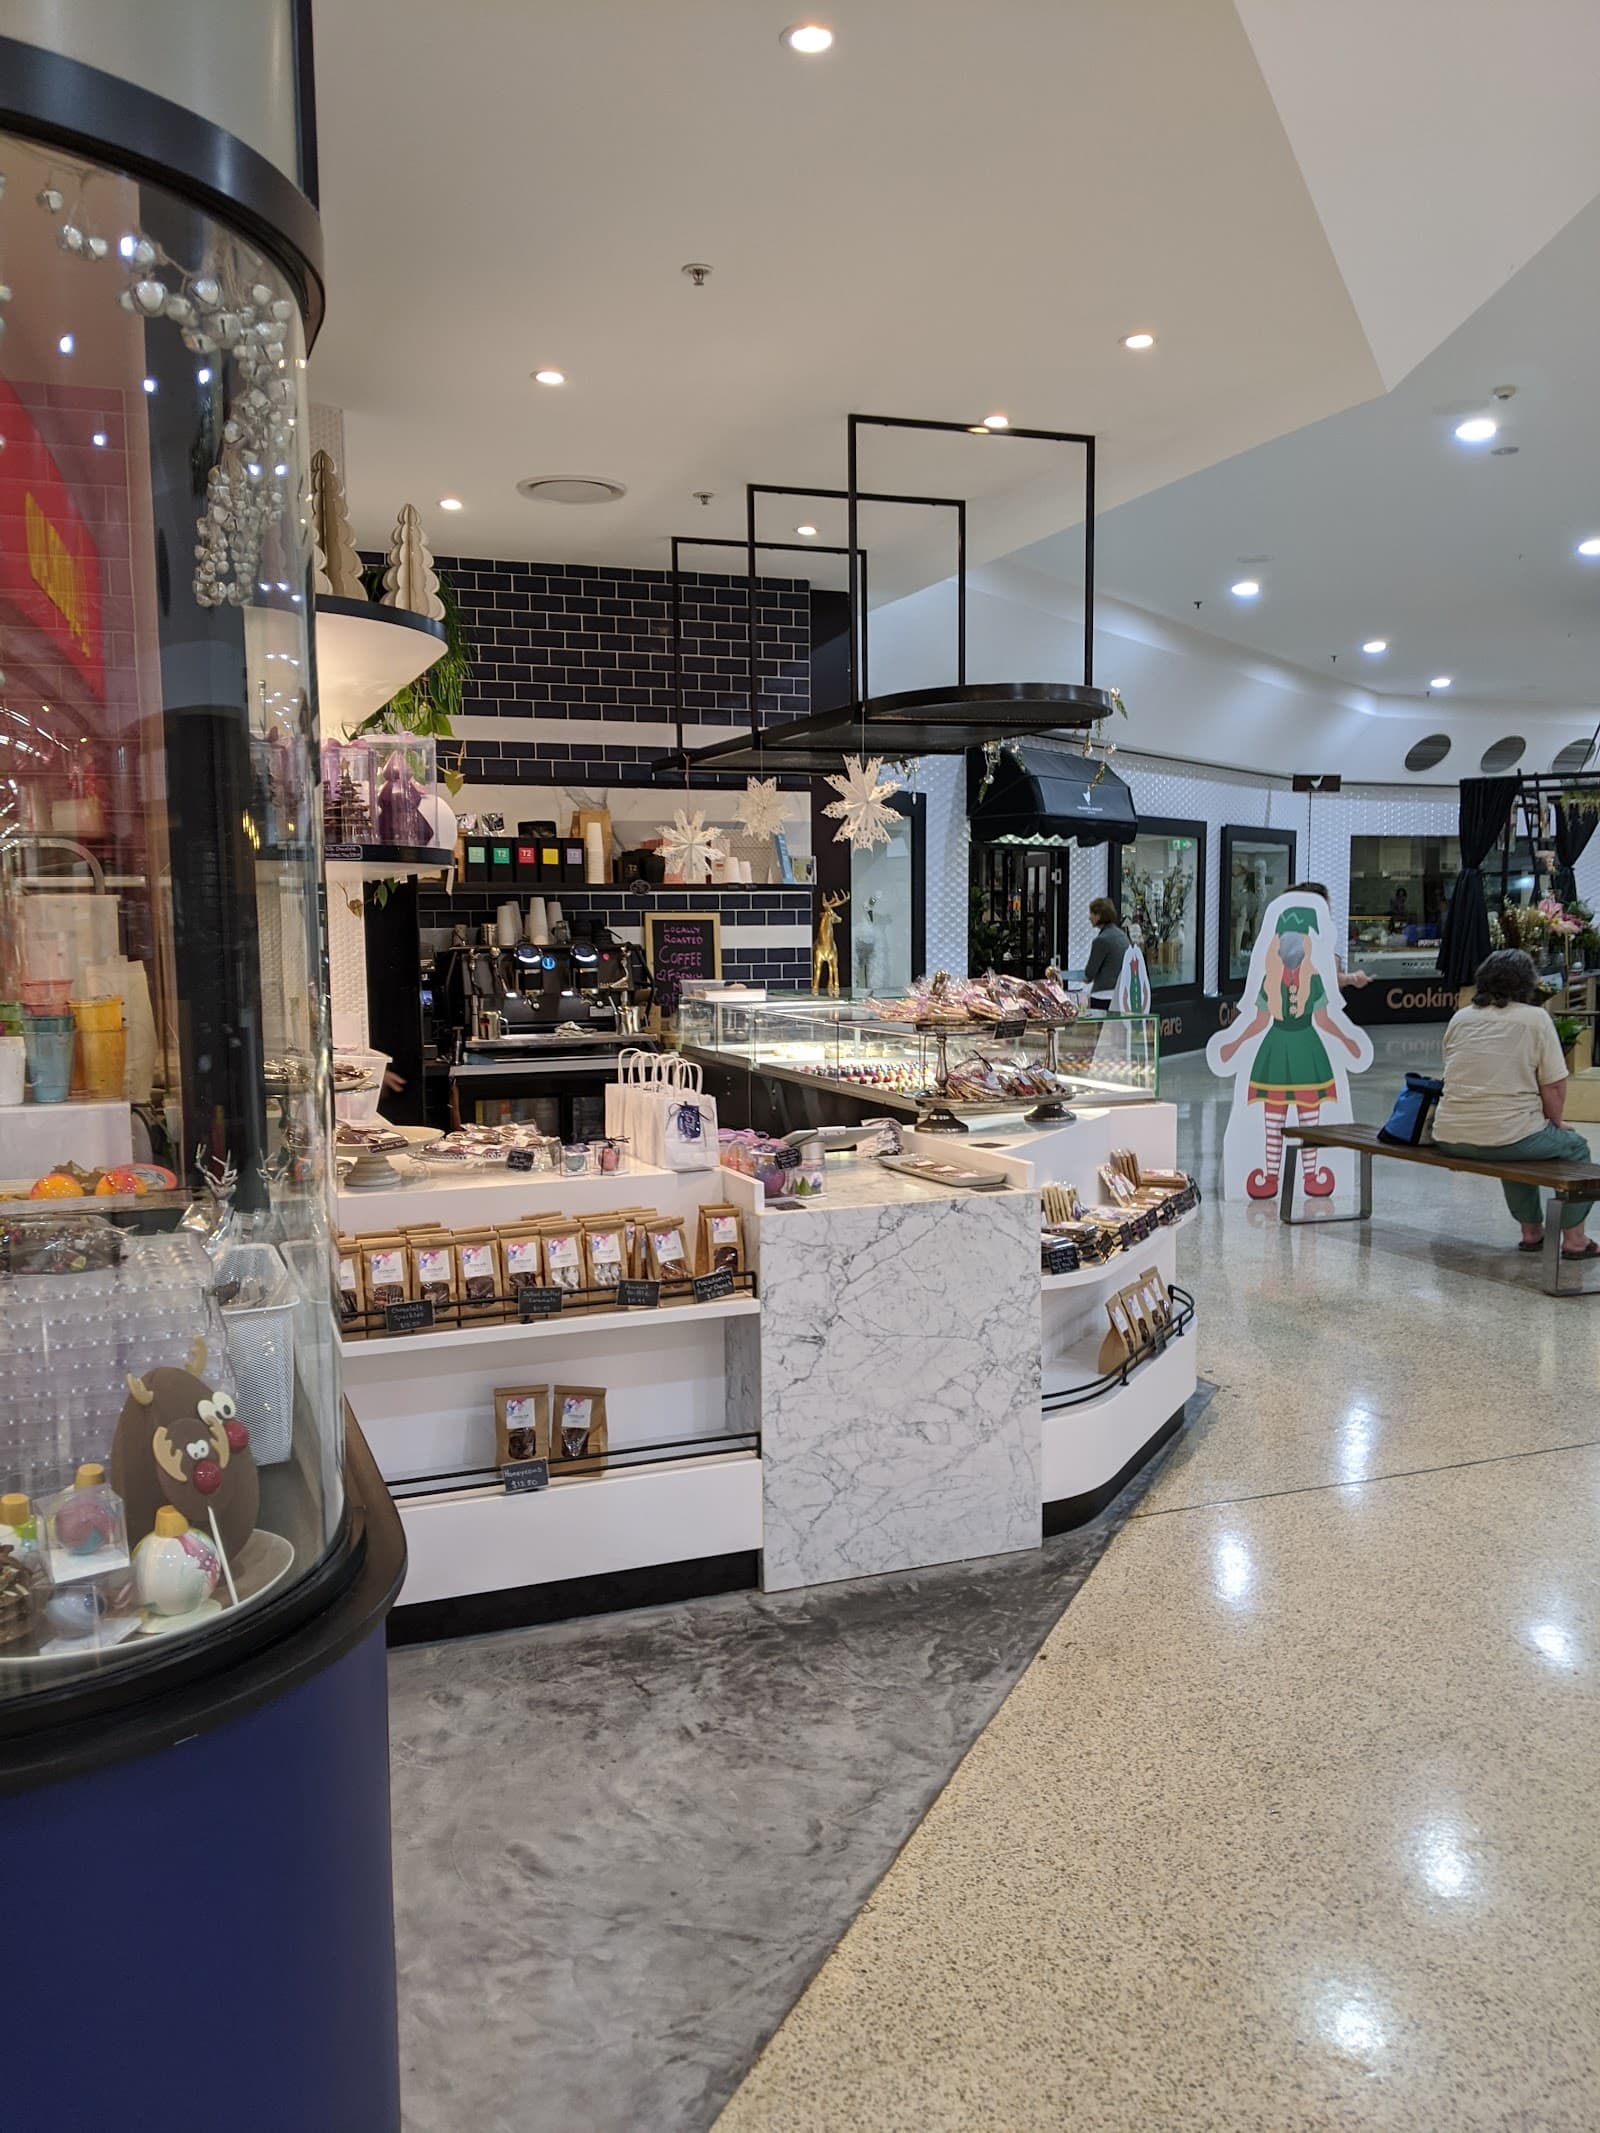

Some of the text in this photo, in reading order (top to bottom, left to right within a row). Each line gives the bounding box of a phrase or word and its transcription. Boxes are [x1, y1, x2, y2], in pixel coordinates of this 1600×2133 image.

[663, 935, 704, 944] ROASTED
[658, 946, 702, 966] COFFEE
[1219, 1001, 1238, 1026] Cul
[504, 1467, 543, 1477] Honeycomb
